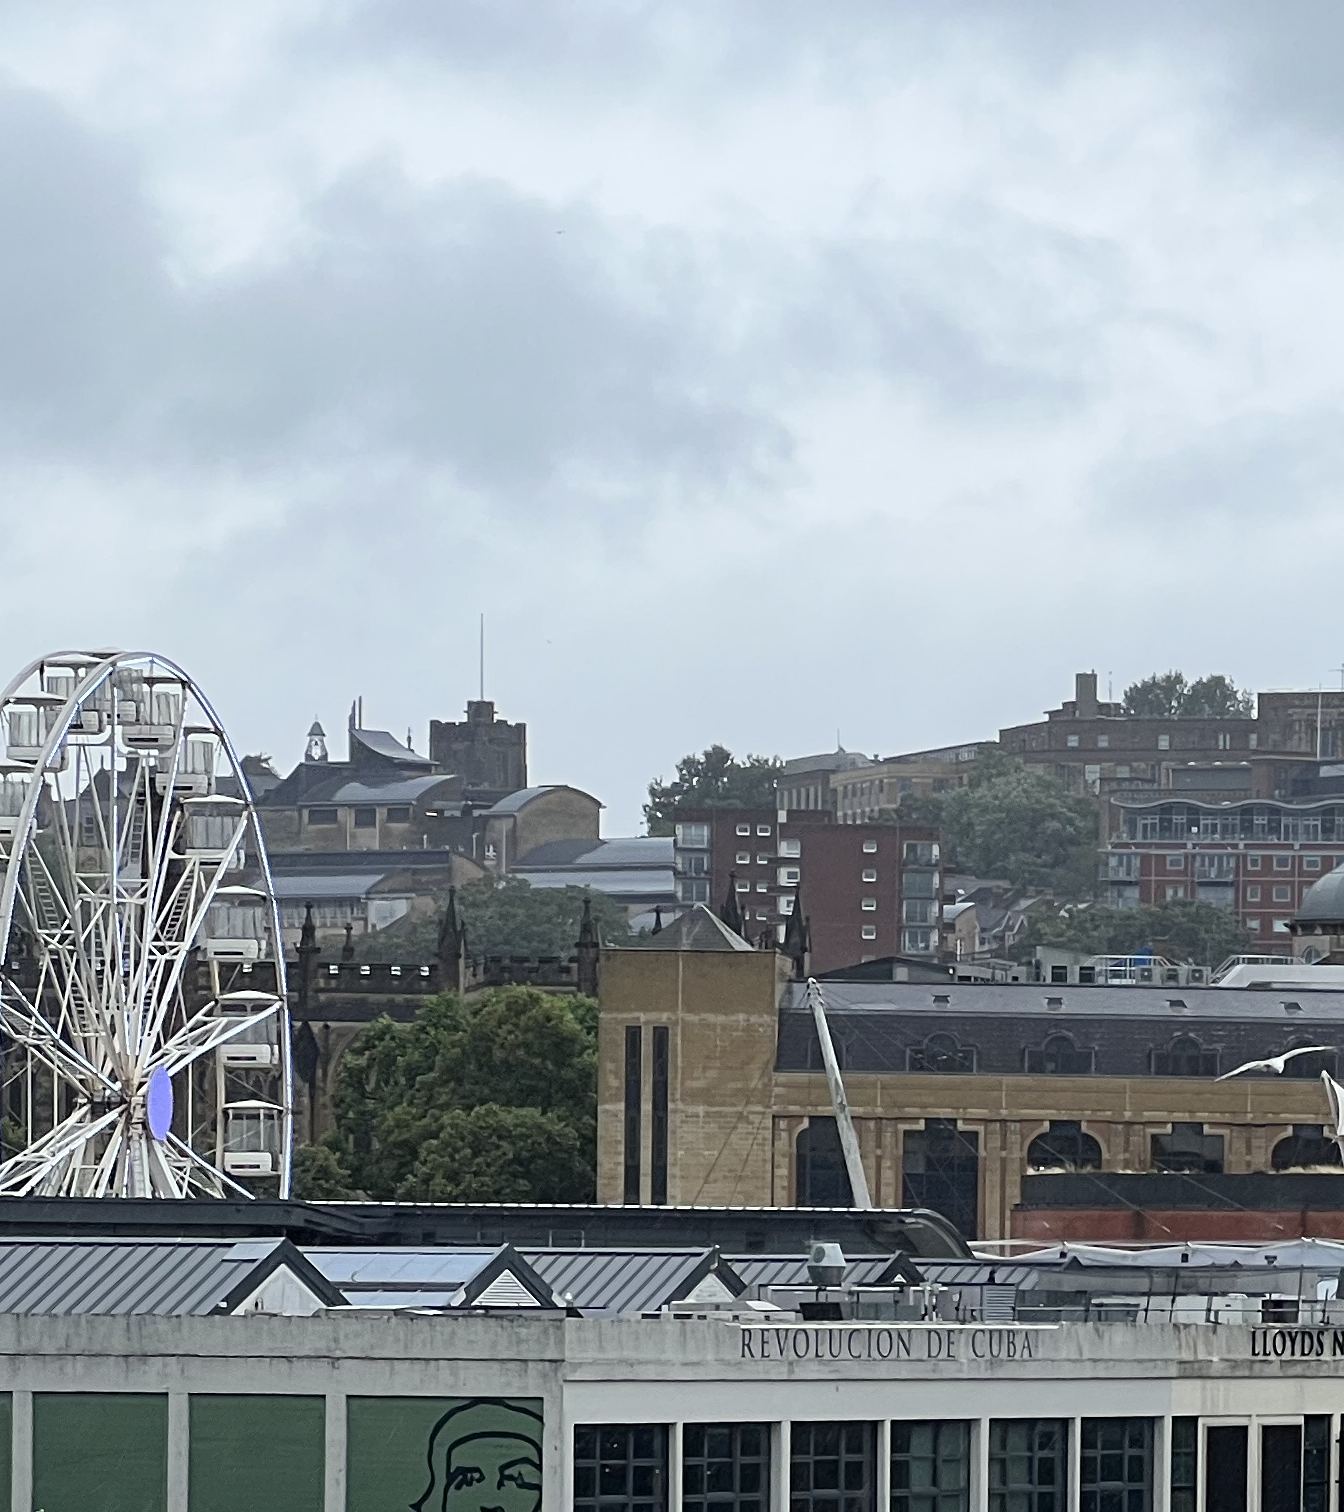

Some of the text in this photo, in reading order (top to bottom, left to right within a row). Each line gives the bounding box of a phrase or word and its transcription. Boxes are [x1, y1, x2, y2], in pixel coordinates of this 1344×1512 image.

[740, 1328, 1034, 1359] REVOLUCION DE CUBA
[1251, 1330, 1325, 1357] LLOYDS
